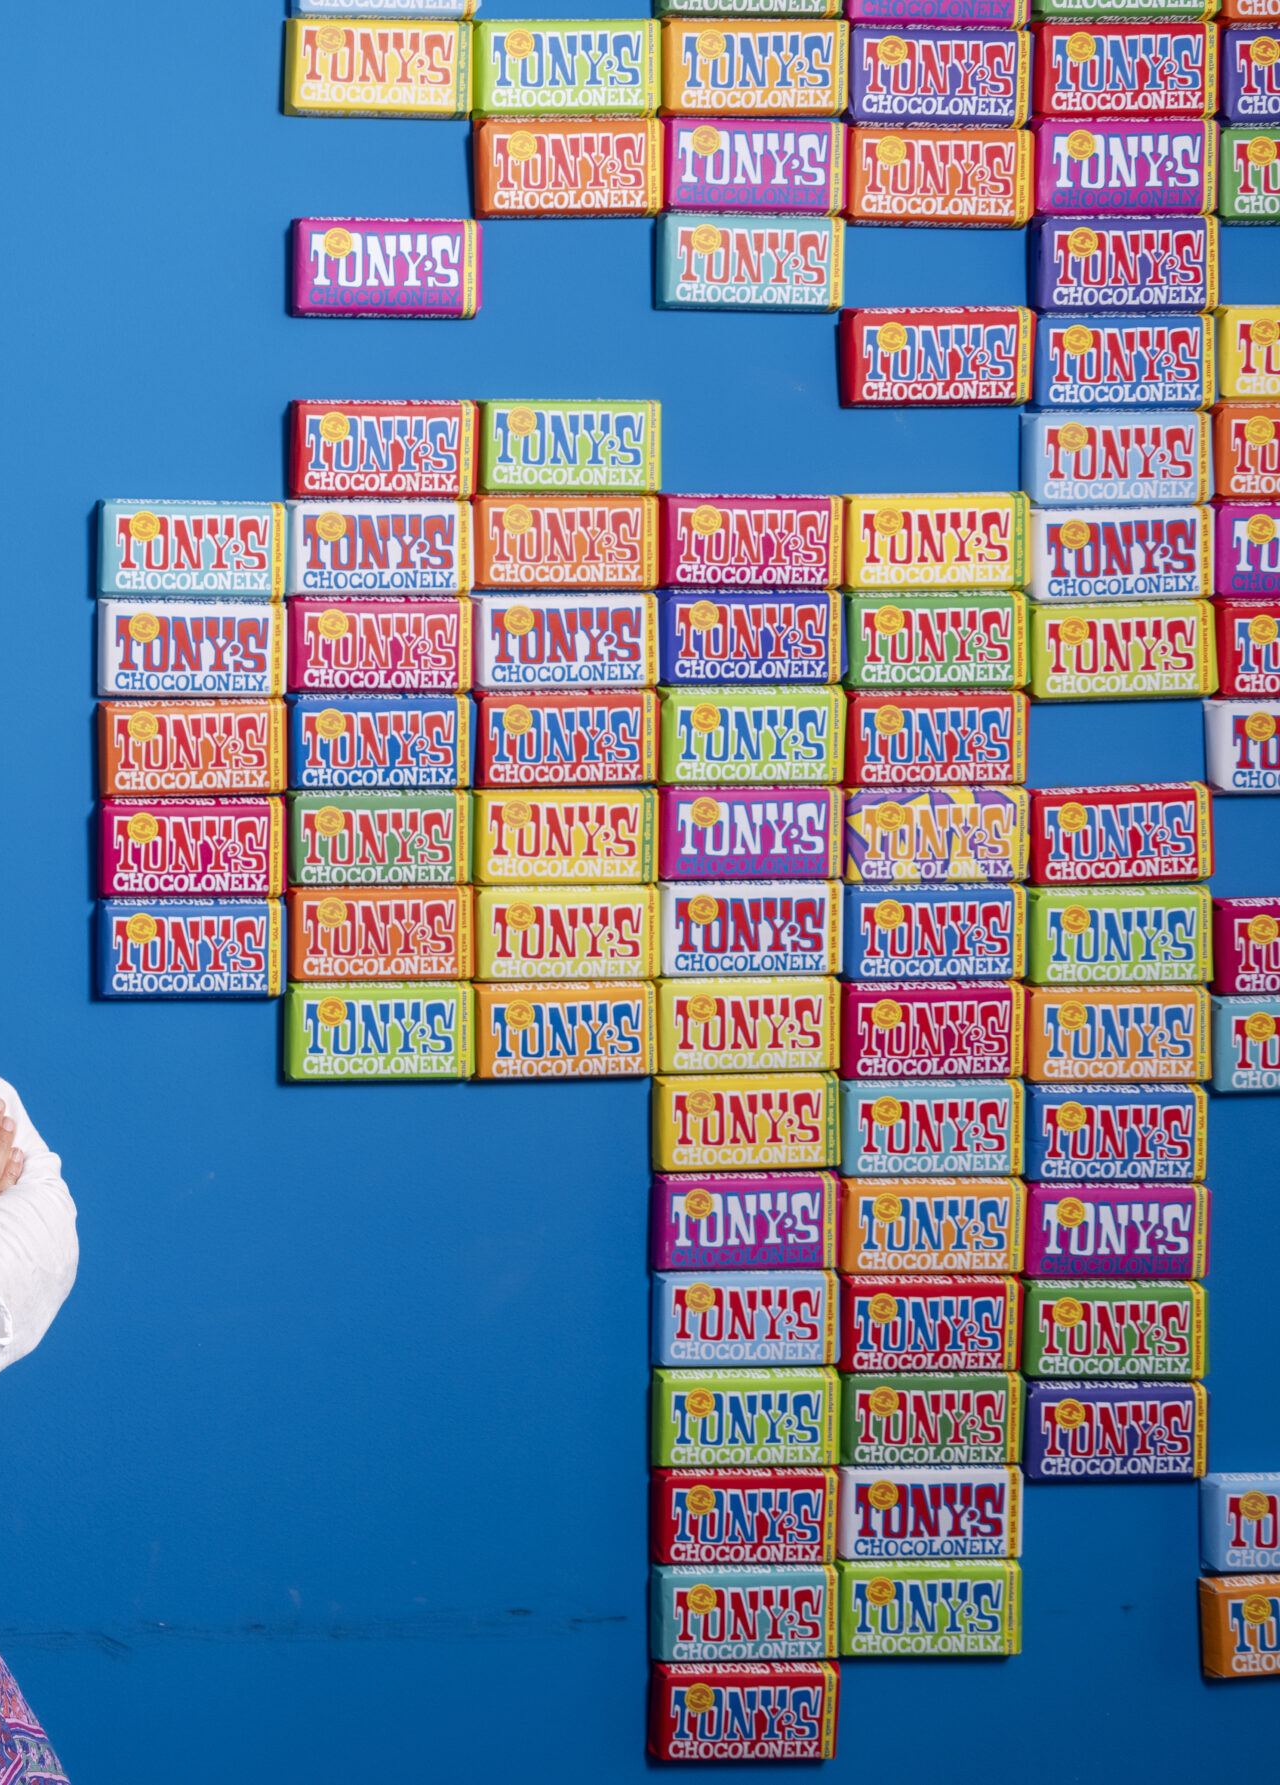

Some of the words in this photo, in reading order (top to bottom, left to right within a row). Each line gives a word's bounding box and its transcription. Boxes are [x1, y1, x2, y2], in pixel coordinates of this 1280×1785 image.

[682, 30, 834, 89] TONY'S
[1052, 33, 1204, 92] TONY'S
[494, 132, 646, 191] TONY'S
[310, 230, 462, 289] TONY'S
[1054, 228, 1206, 287] TONY'S
[306, 414, 458, 473] TONY'S
[677, 507, 829, 566] TONY'S
[115, 614, 271, 673] TONY'S
[676, 603, 828, 660] TONY'S
[114, 712, 270, 771] TONY'S
[303, 709, 455, 768] TONY'S
[113, 814, 269, 873] TONY'S
[112, 915, 268, 974] TONY'S
[675, 896, 827, 953] TONY'S
[304, 997, 456, 1056] TONY'S
[1044, 1003, 1196, 1060] TONY'S
[1042, 1103, 1194, 1160] TONY'S
[1039, 1299, 1191, 1356] TONY'S
[1041, 1400, 1193, 1457] TONY'S
[855, 1482, 1007, 1539] TONY'S
[852, 1578, 1004, 1635] TONY'S
[670, 1686, 822, 1741] TONY'S
